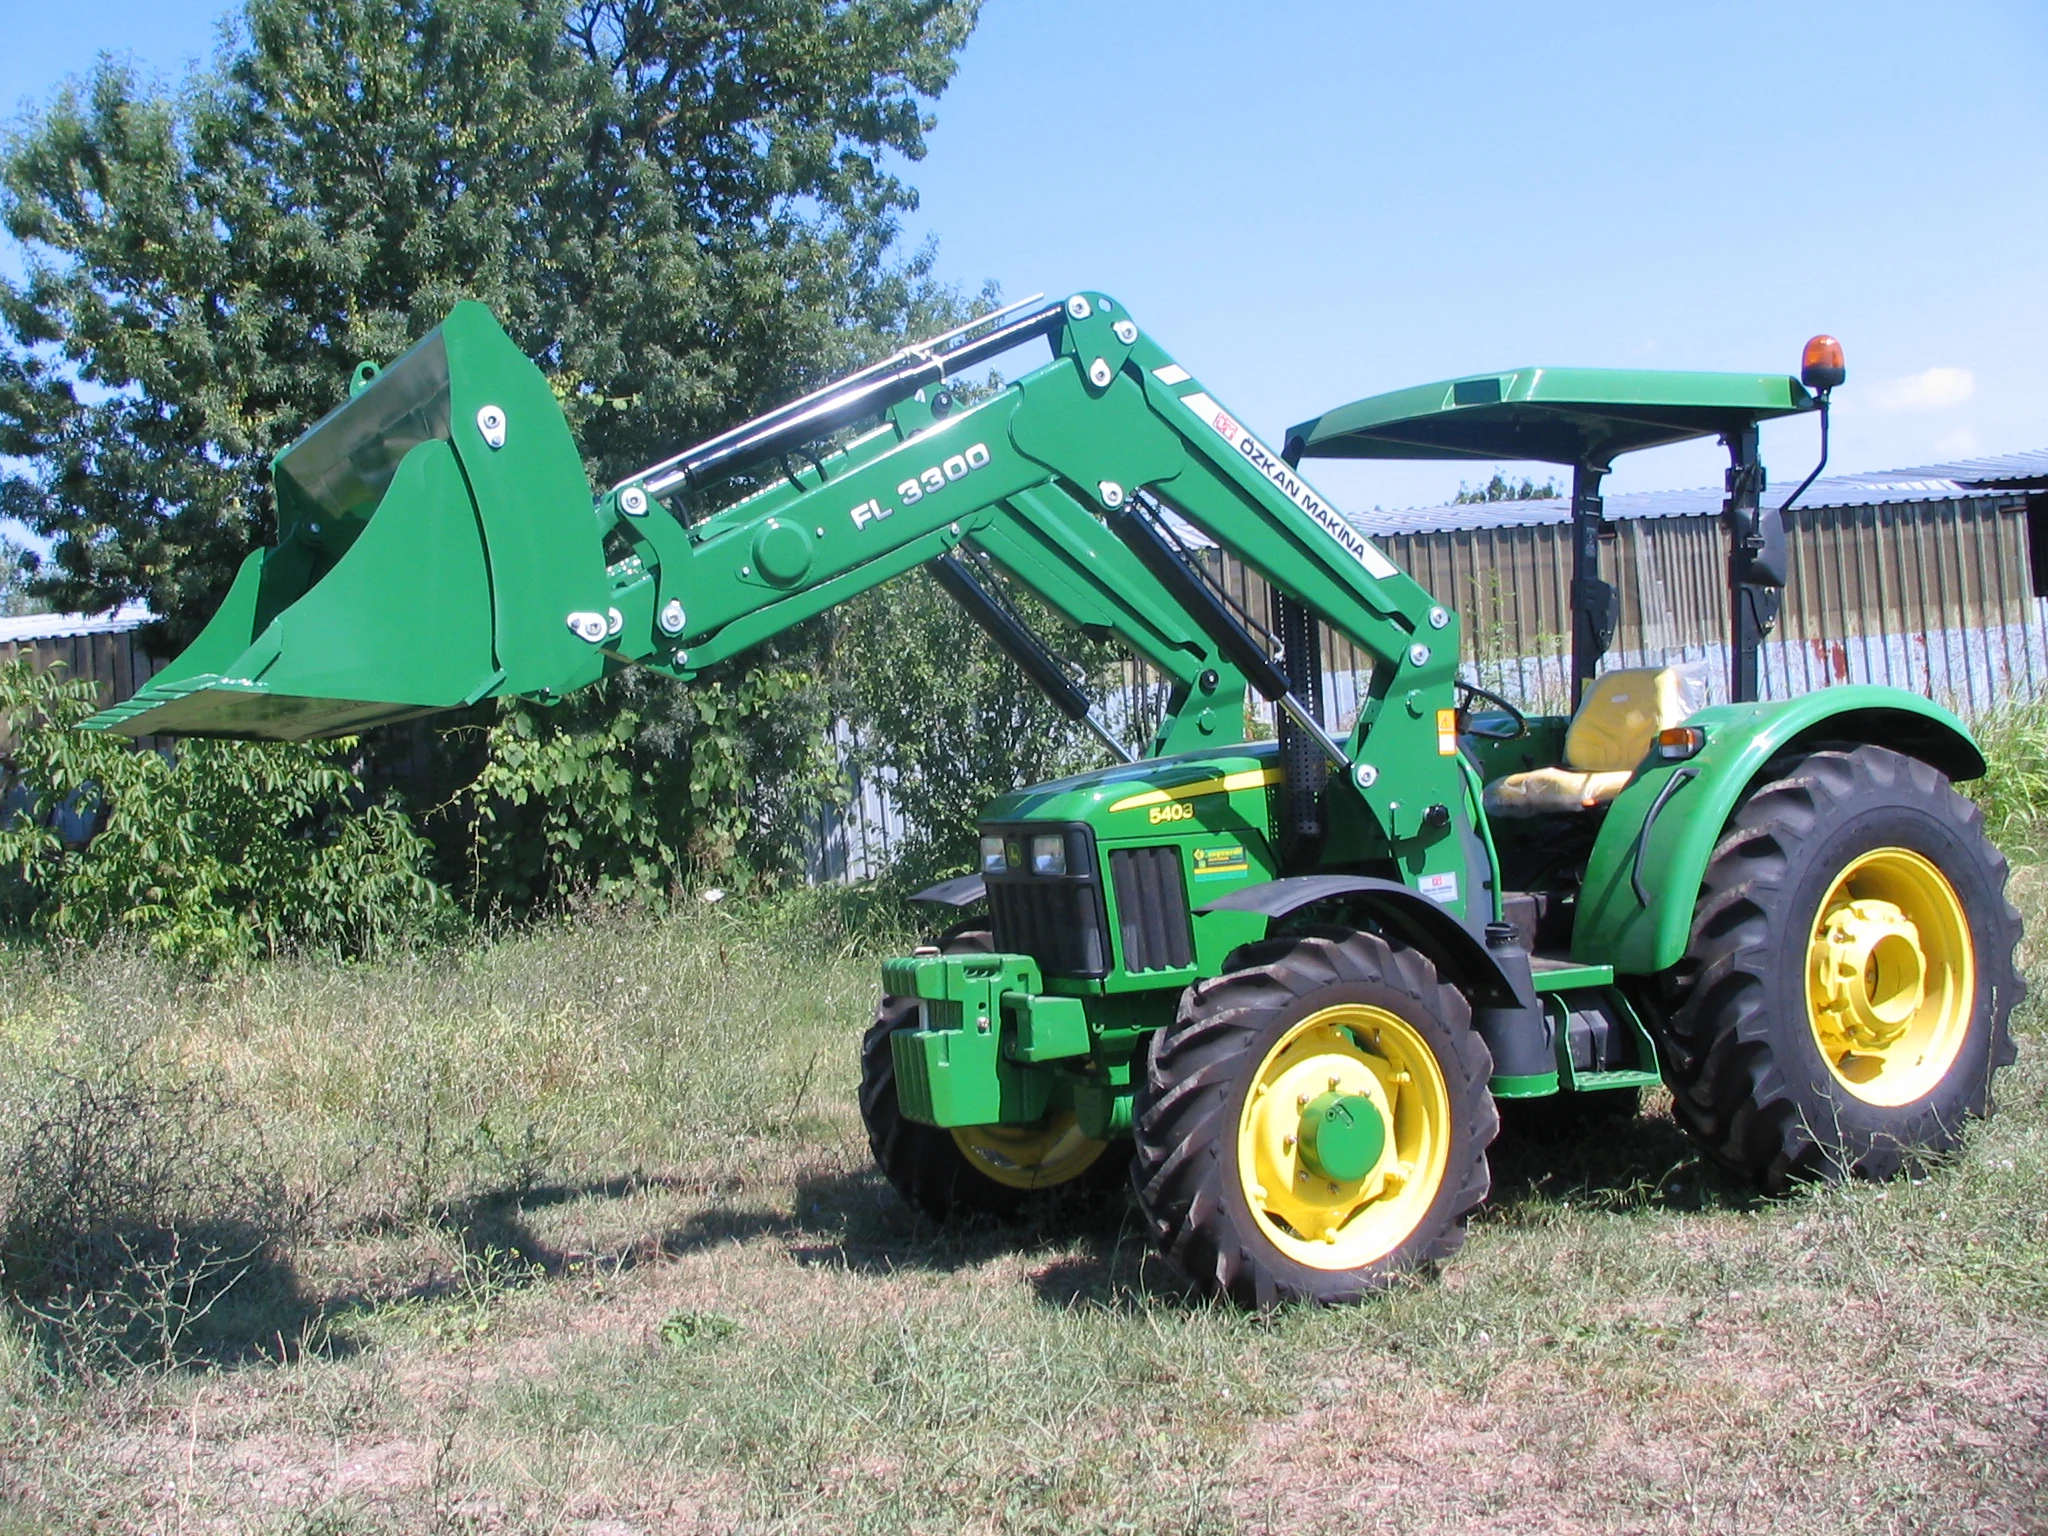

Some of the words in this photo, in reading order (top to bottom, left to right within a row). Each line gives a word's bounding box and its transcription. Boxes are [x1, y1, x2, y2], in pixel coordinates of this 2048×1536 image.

[850, 498, 894, 532] FL
[896, 442, 991, 506] 3300
[1239, 437, 1300, 498] ÖZKAN
[1301, 494, 1365, 560] MAKİNA
[1149, 803, 1195, 825] 5403
